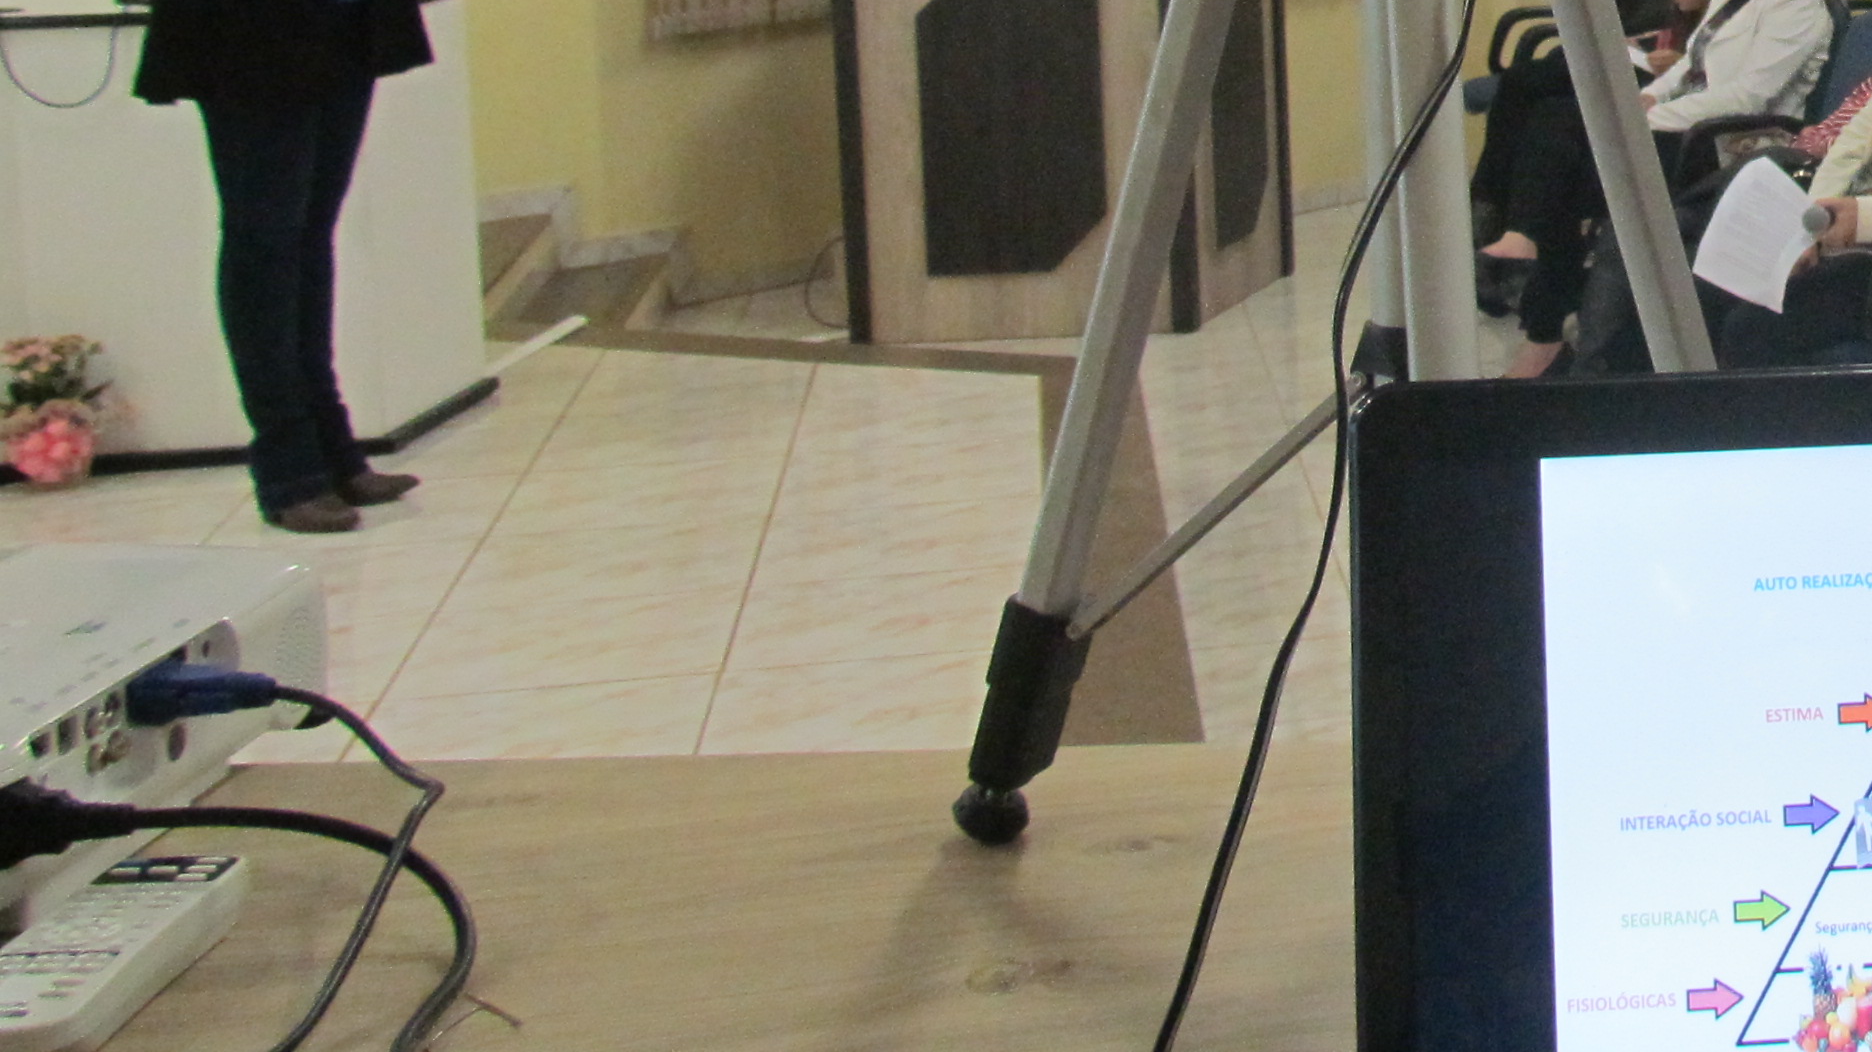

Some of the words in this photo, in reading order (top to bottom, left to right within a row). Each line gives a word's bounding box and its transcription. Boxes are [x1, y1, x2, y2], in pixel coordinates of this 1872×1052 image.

[1754, 576, 1797, 592] AUTO
[1765, 707, 1824, 723] ESTIMA
[1620, 810, 1712, 831] INTERAÇÃO
[1716, 809, 1772, 826] SOCIAL
[1621, 909, 1720, 928] SEGURANÇA
[1567, 991, 1677, 1013] FISIOLÓGICAS
